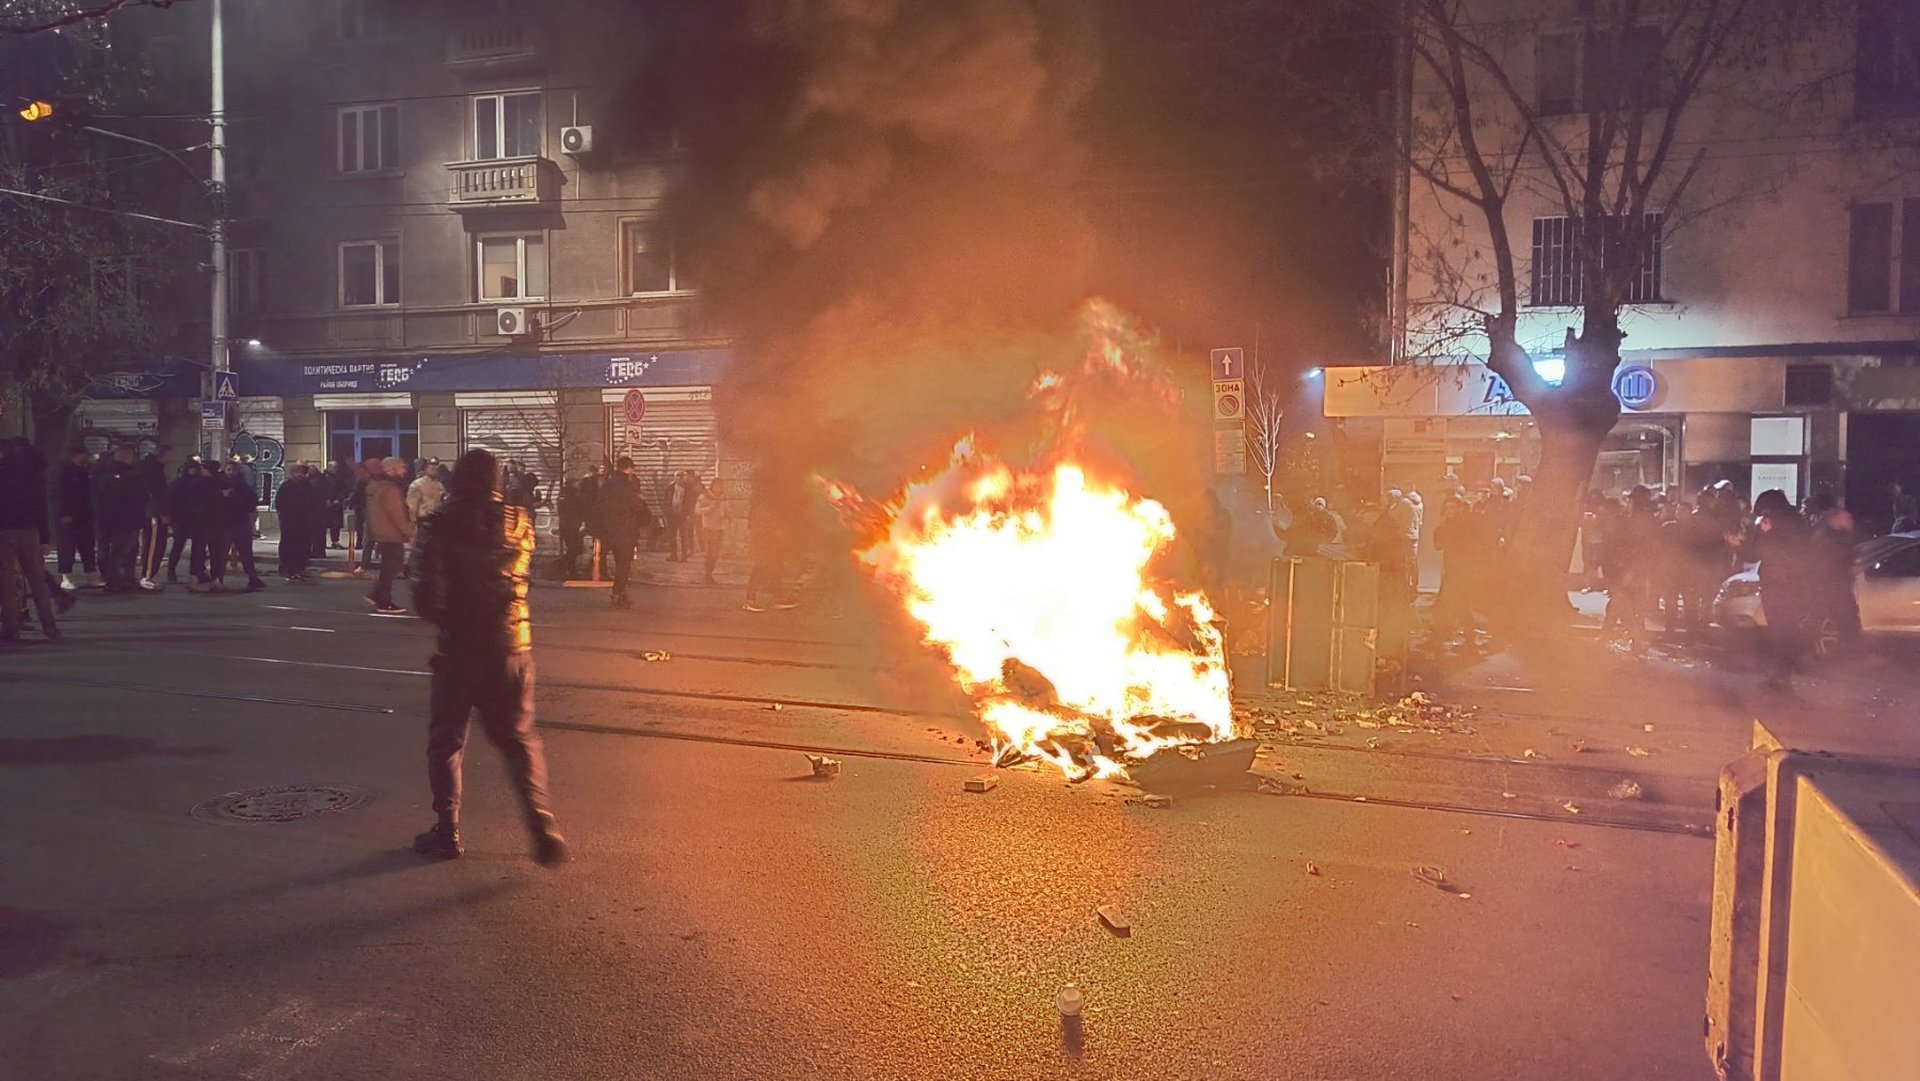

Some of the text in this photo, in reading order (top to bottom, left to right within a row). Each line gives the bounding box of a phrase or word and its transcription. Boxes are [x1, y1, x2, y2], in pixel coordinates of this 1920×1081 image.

[304, 366, 347, 375] ПОЛИТИЧЕСКА
[380, 368, 409, 381] ГЕРБ
[611, 362, 643, 377] ГЕРБ
[1215, 384, 1240, 393] ЗОНА
